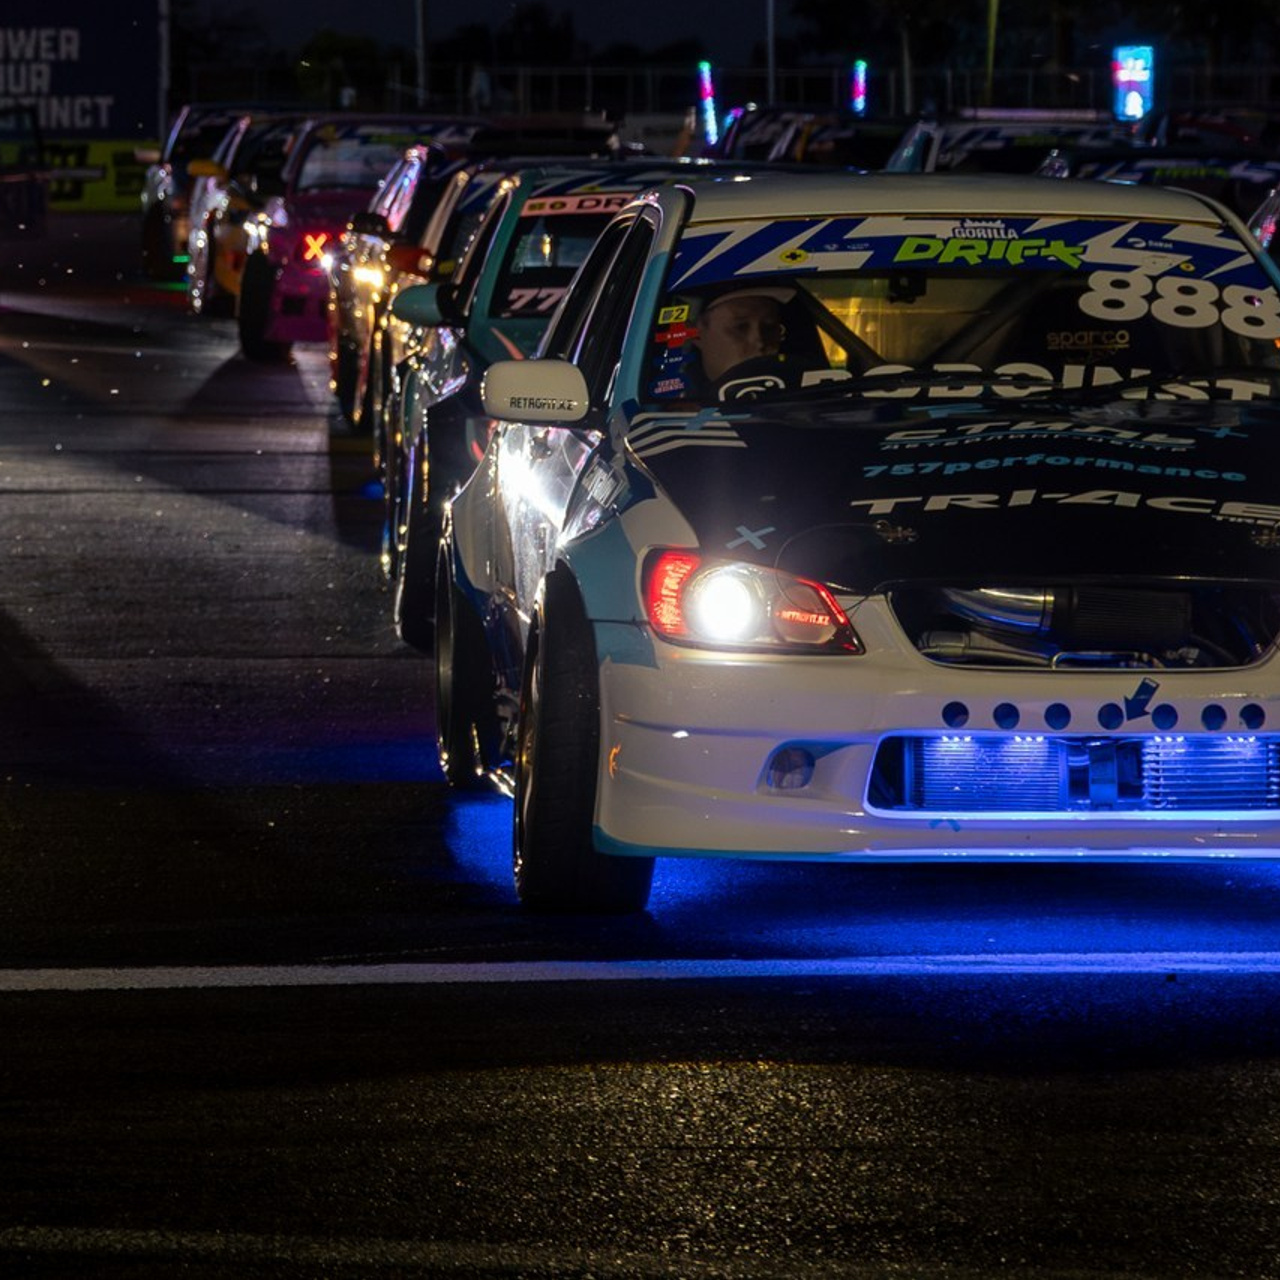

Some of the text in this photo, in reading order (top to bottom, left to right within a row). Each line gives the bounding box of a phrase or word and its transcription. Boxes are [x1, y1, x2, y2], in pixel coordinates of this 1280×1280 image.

[953, 227, 1020, 240] GORILLA
[1077, 270, 1280, 341] 888
[1045, 329, 1131, 349] sparco
[862, 452, 1248, 482] 757performance
[850, 488, 1280, 519] TRI-ACE
